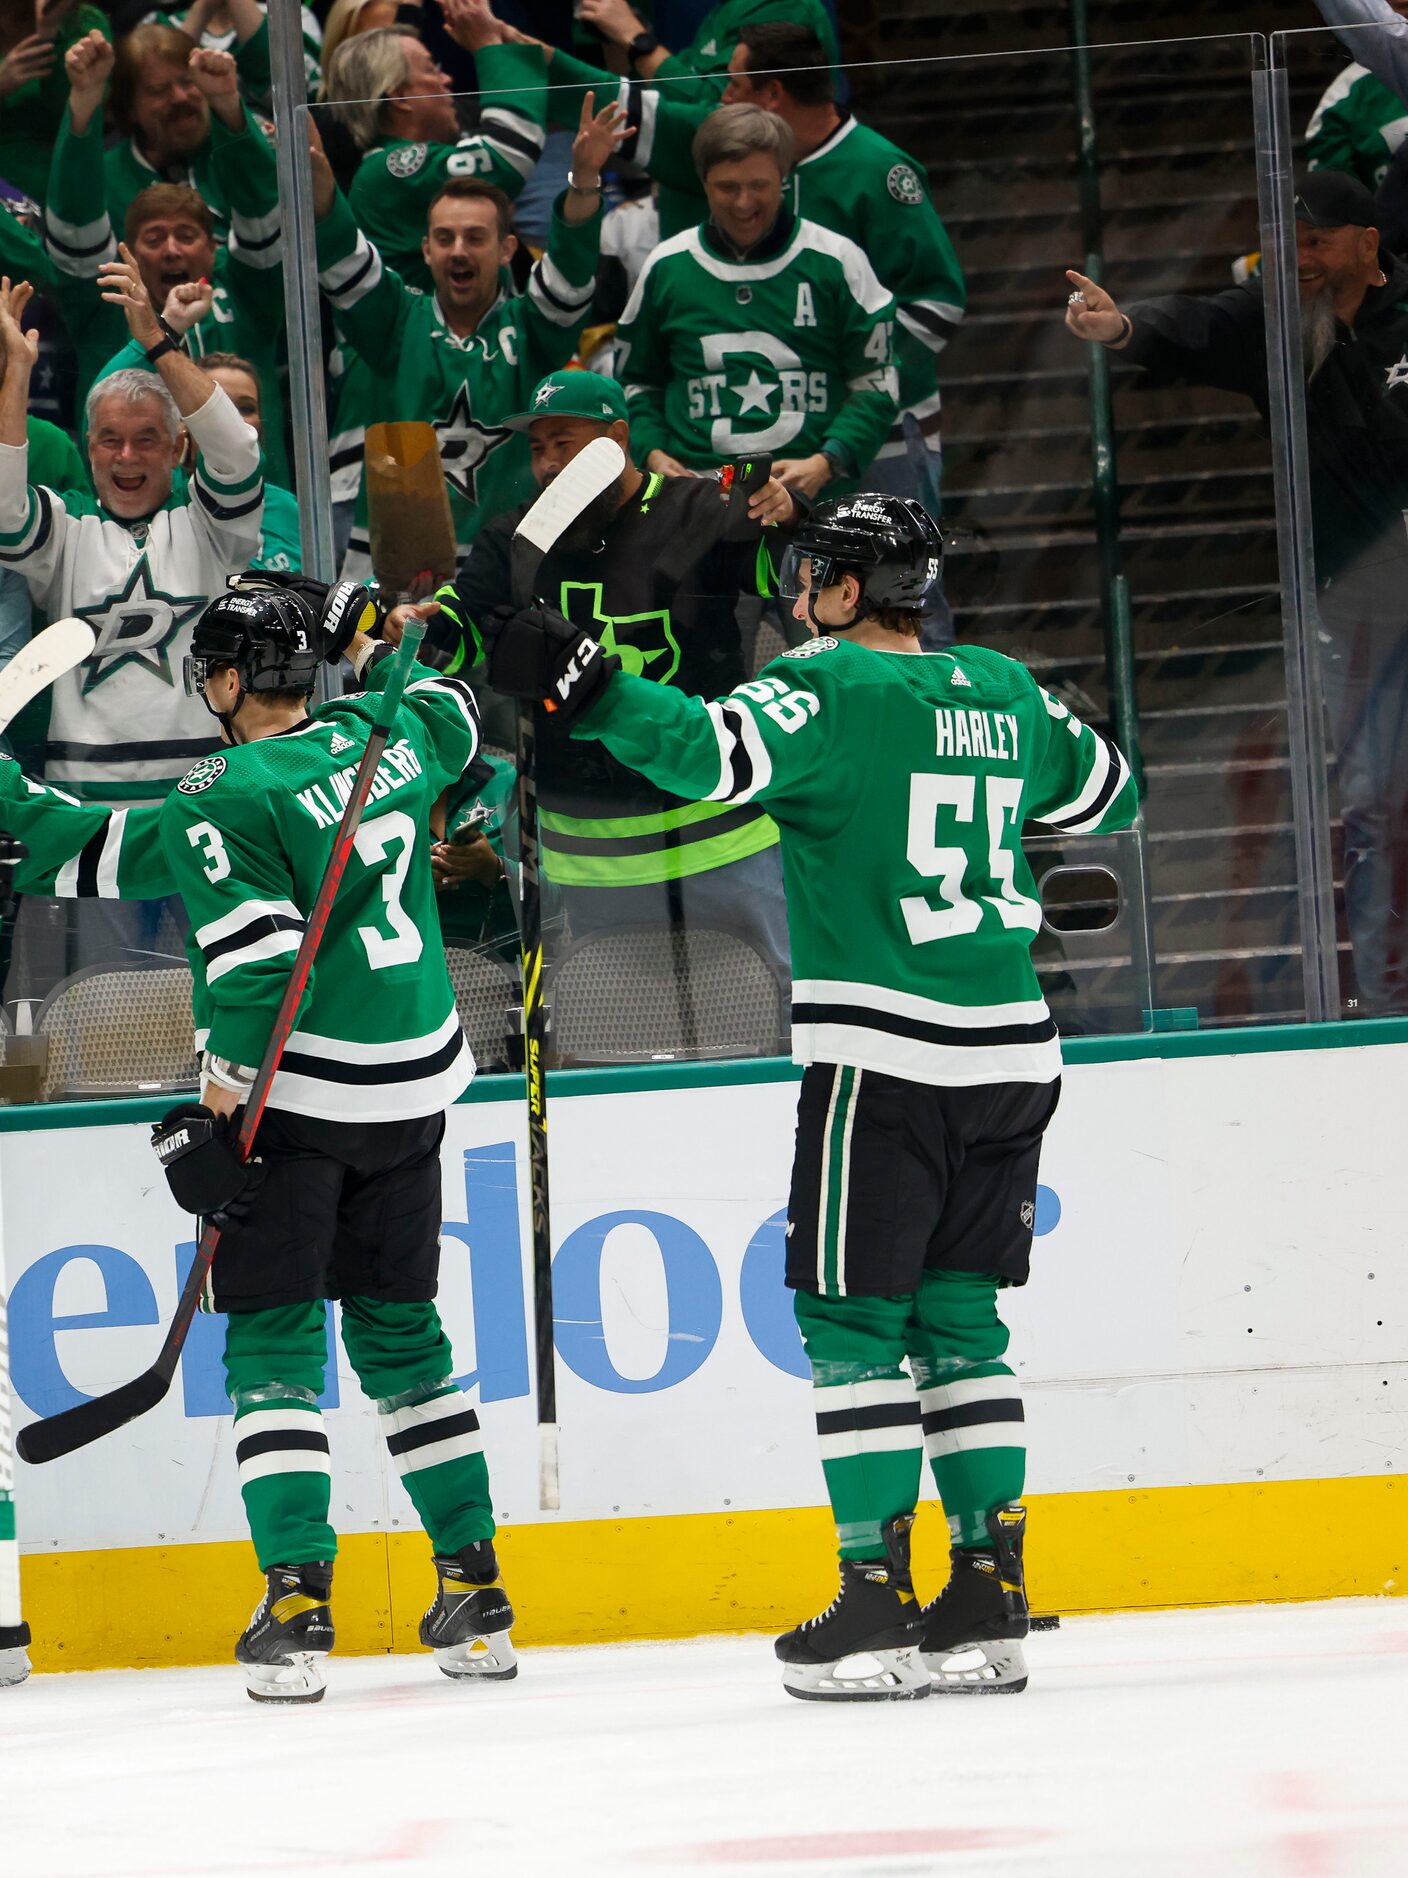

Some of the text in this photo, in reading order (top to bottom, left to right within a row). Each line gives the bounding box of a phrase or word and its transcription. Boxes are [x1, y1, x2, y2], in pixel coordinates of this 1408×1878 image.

[793, 282, 817, 327] A
[498, 326, 518, 365] C
[851, 502, 885, 514] ENERGY
[851, 510, 892, 524] TRANSFER
[926, 557, 939, 580] 55
[226, 603, 258, 618] TRANSFER
[229, 596, 256, 608] ENERGY
[296, 630, 308, 650] 3
[555, 637, 600, 701] CM
[330, 739, 356, 755] adidas
[935, 709, 1019, 761] HARLEY
[185, 821, 232, 884] 3
[899, 772, 1043, 946] 55
[353, 810, 424, 970] 3
[1347, 998, 1358, 1008] 31
[529, 1038, 543, 1116] SUPER
